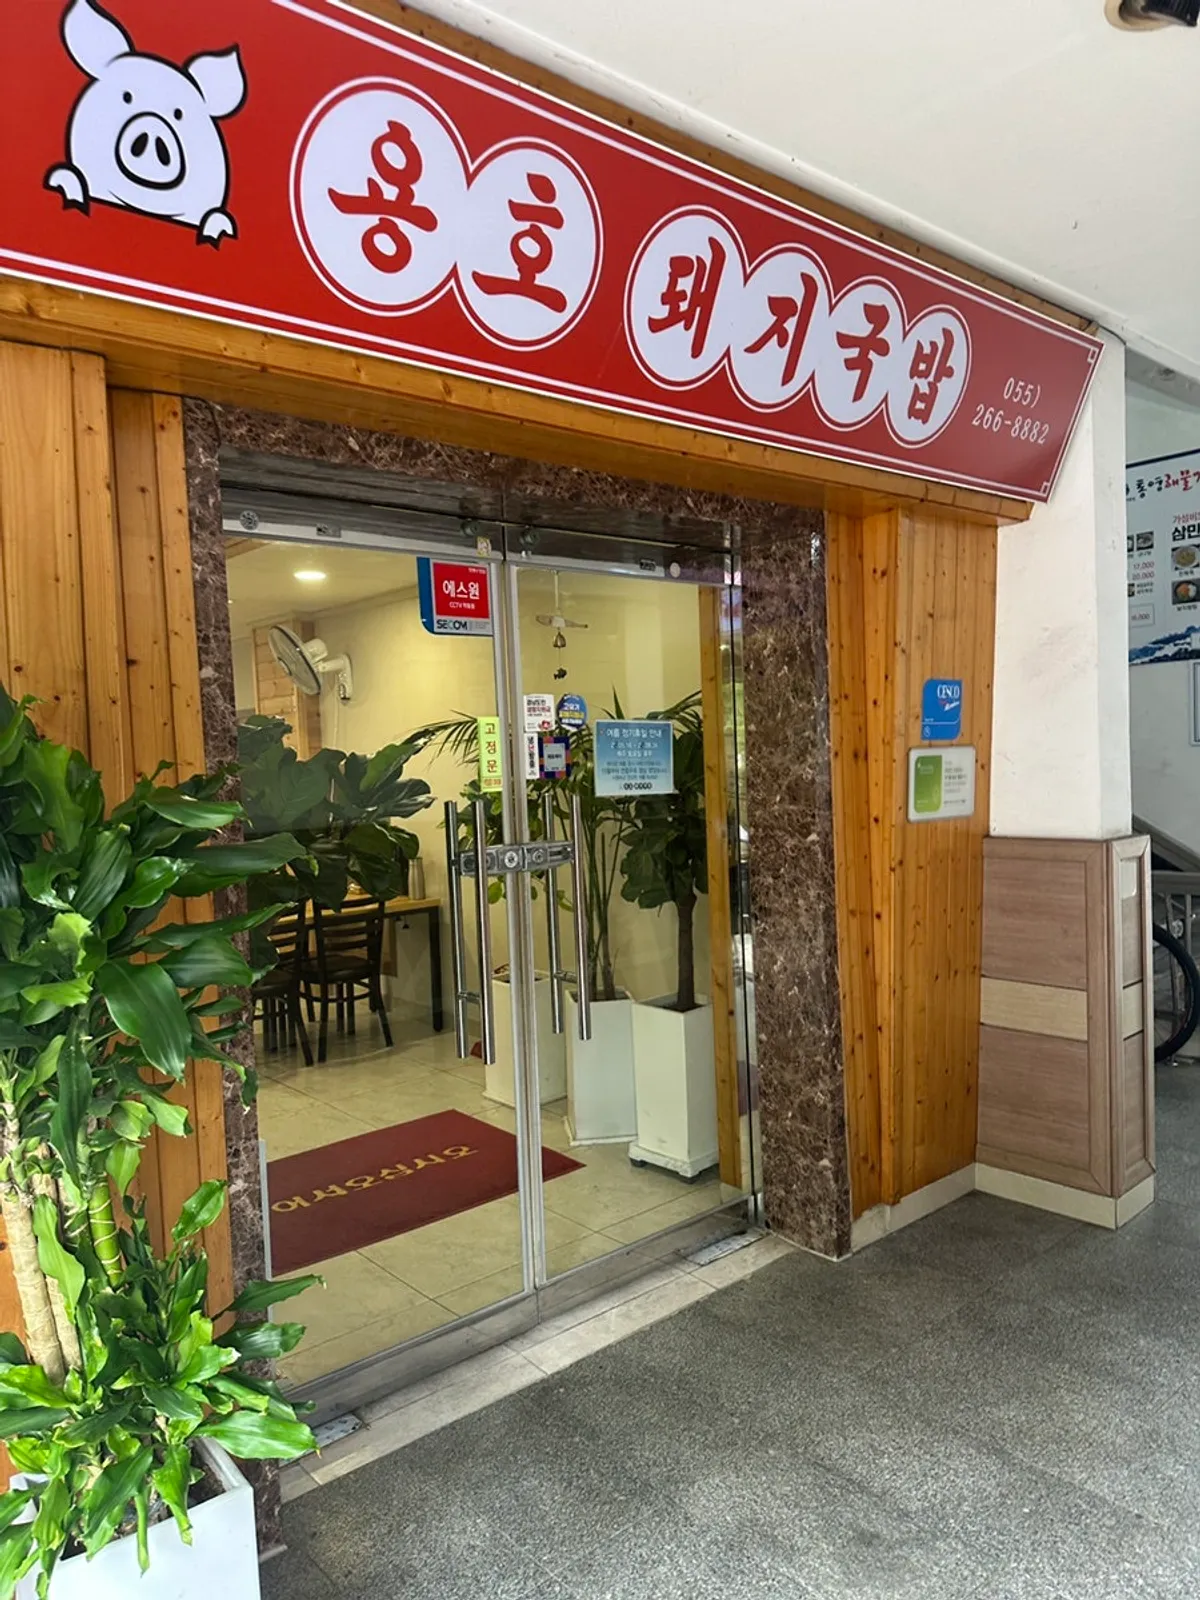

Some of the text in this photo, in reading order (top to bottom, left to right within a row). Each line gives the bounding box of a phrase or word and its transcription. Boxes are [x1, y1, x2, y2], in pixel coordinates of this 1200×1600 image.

[328, 120, 956, 426] 용호 돼지국밥
[1003, 377, 1041, 408] 055)
[971, 403, 1050, 445] 266-8882
[442, 579, 480, 600] 에스원
[436, 618, 468, 631] SECOM
